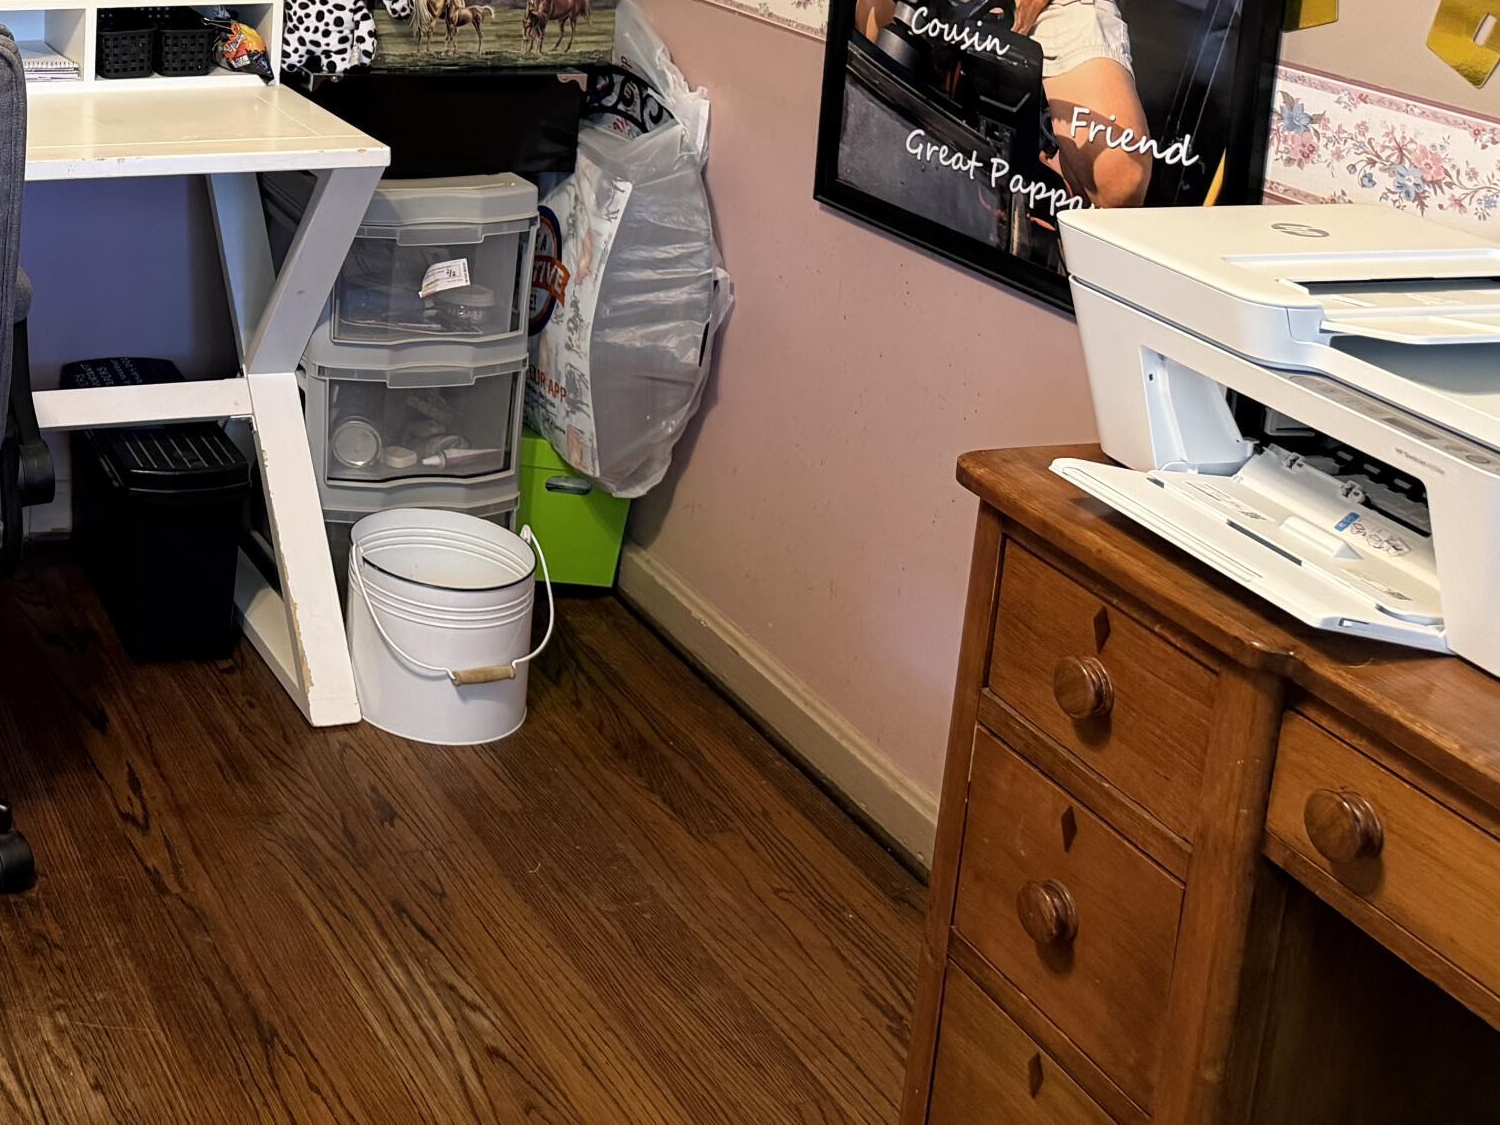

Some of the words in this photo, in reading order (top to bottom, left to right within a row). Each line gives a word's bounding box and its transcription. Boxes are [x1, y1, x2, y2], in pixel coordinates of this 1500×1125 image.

[908, 6, 1010, 56] Cousin
[1070, 107, 1200, 167] Friend
[906, 130, 984, 179] Great
[989, 158, 1096, 216] Pappa
[548, 378, 567, 403] APP
